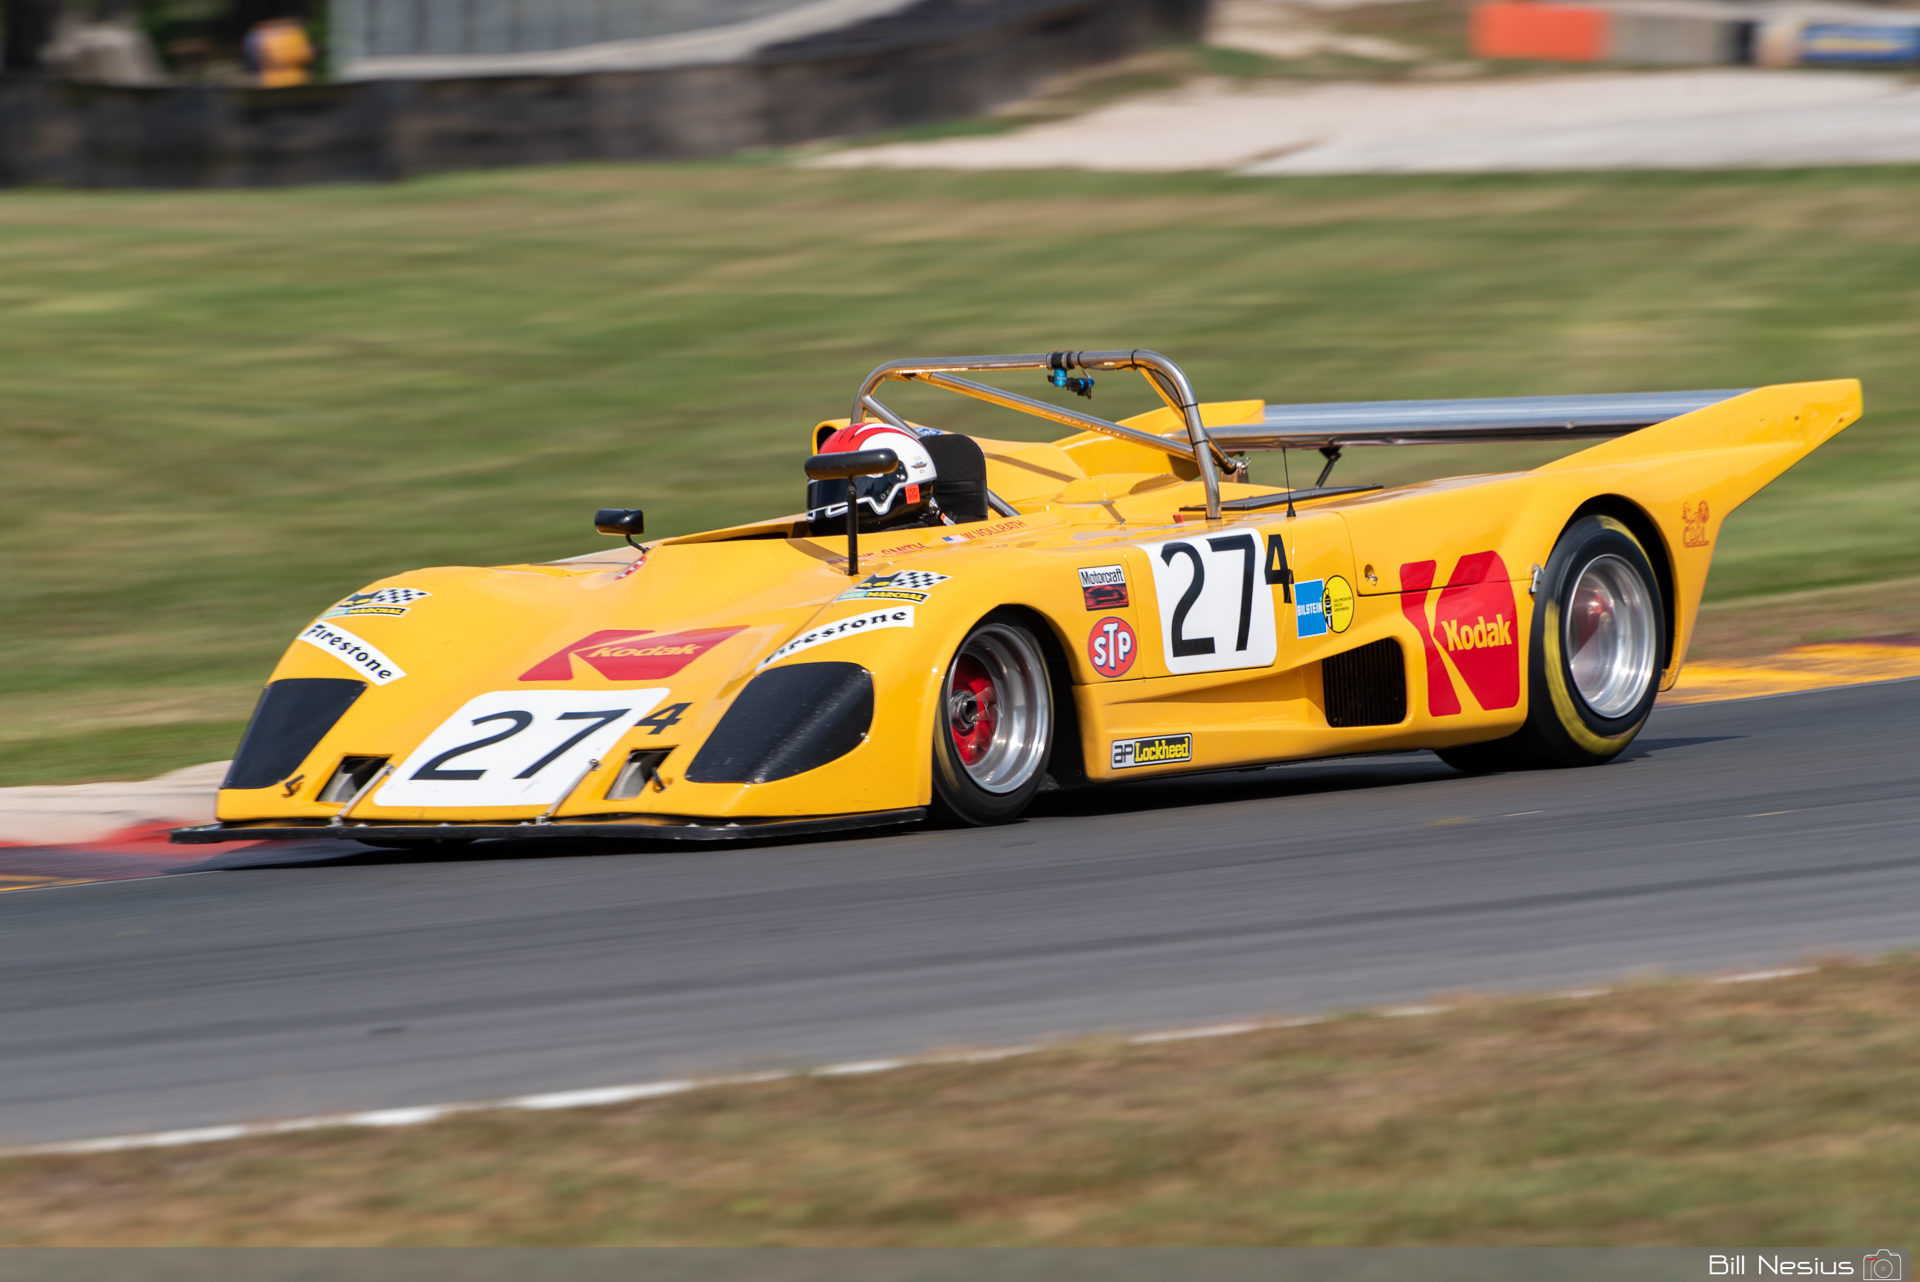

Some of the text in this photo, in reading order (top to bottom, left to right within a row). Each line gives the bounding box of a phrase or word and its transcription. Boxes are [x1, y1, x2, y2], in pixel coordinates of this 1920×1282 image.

[1080, 568, 1124, 585] Motorcraft
[1160, 533, 1294, 658] 27 4
[1297, 601, 1323, 616] BILSTEIN
[302, 624, 393, 680] Firestone
[586, 643, 703, 658] Kodak
[1093, 621, 1133, 670] STP
[1441, 613, 1513, 652] Kodak
[408, 702, 695, 781] 27 4
[1134, 737, 1190, 763] Lockheed
